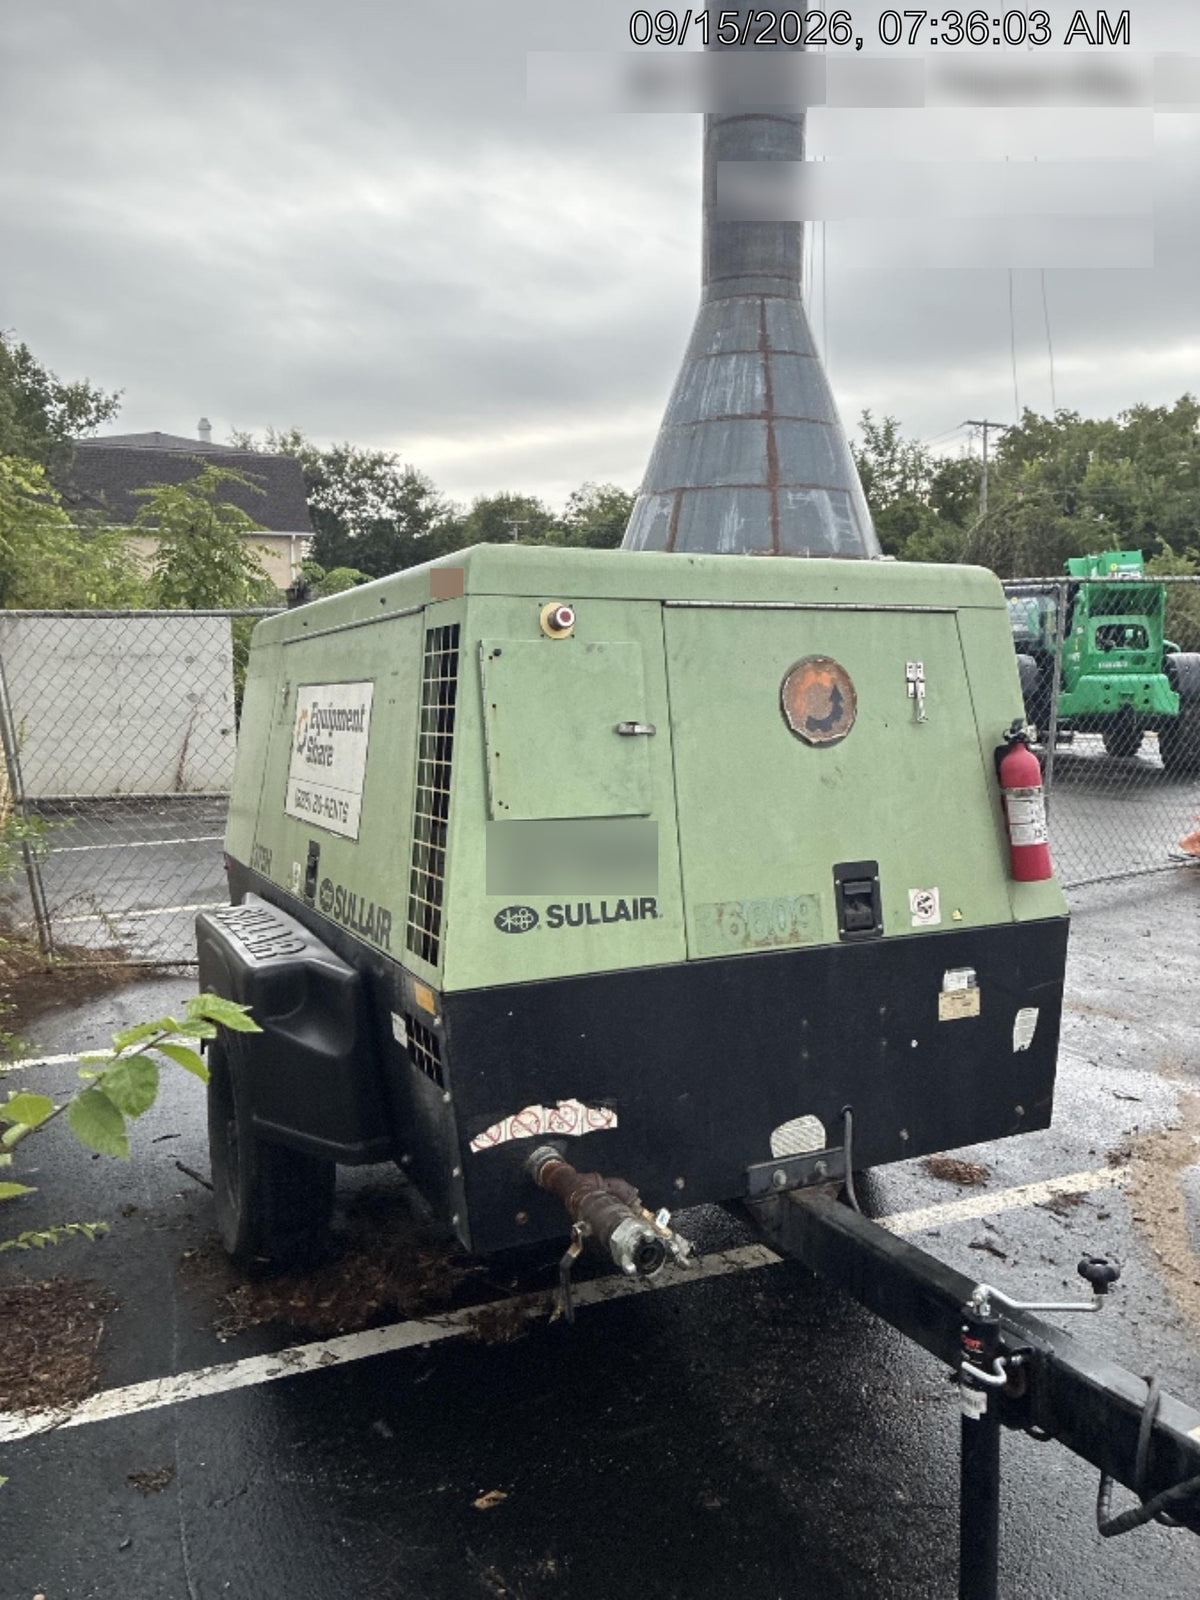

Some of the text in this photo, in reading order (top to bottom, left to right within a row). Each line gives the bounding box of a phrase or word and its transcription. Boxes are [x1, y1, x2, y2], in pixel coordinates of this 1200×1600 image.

[309, 702, 365, 737] Equipment
[305, 735, 333, 767] Share
[333, 884, 392, 951] SULLAIR
[546, 897, 658, 928] SULLAIR
